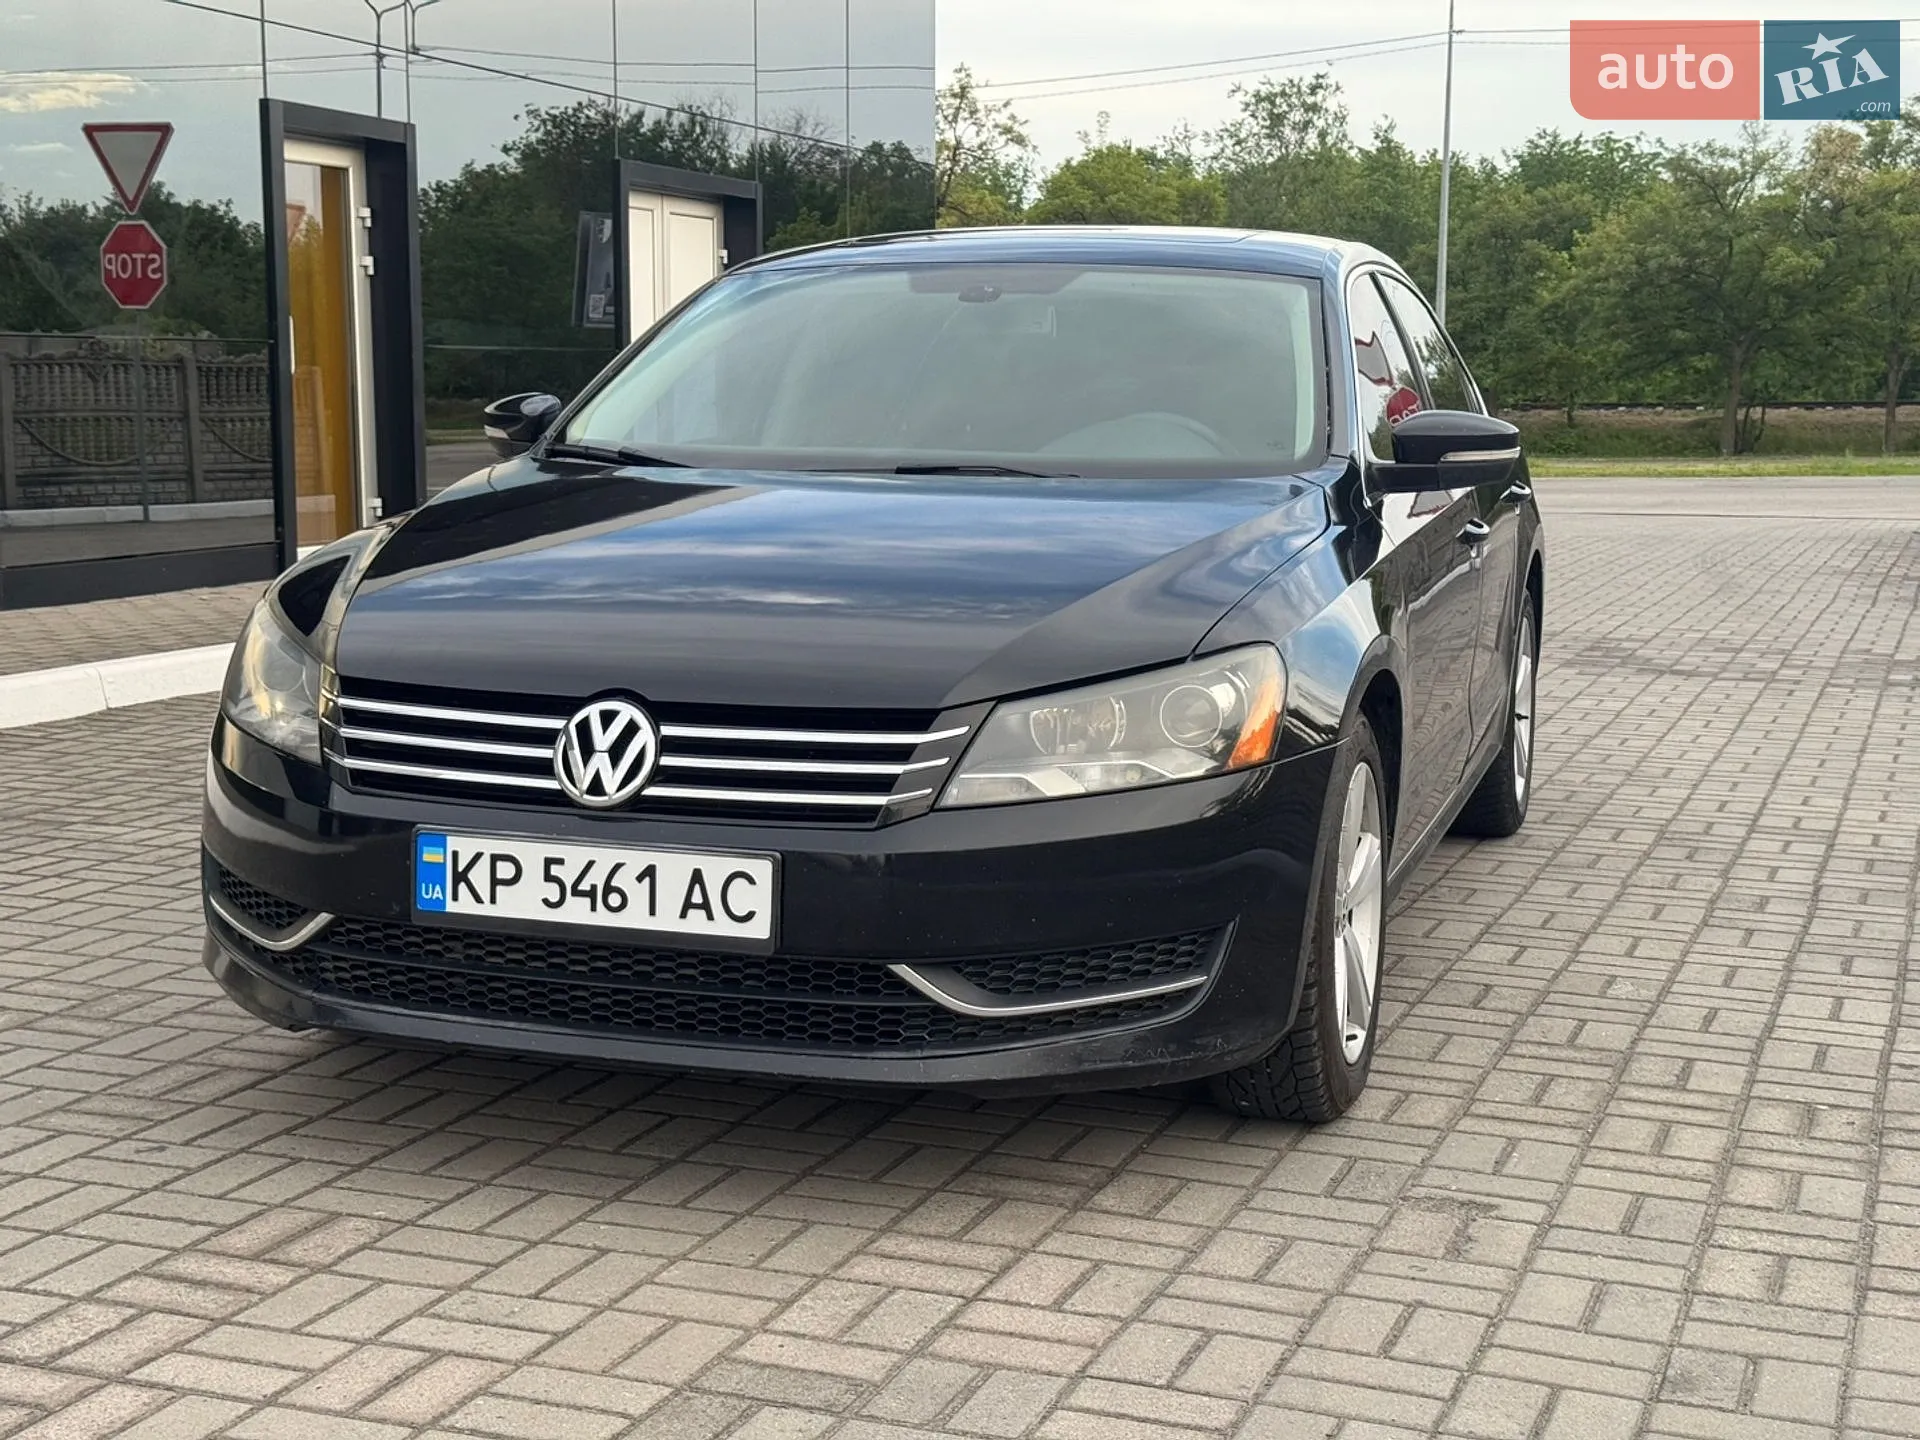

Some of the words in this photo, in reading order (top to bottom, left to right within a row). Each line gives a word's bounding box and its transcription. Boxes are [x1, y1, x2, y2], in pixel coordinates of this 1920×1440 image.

[421, 882, 443, 900] UA
[451, 850, 523, 905] KP
[541, 856, 657, 916] 5461
[679, 868, 757, 923] AC
